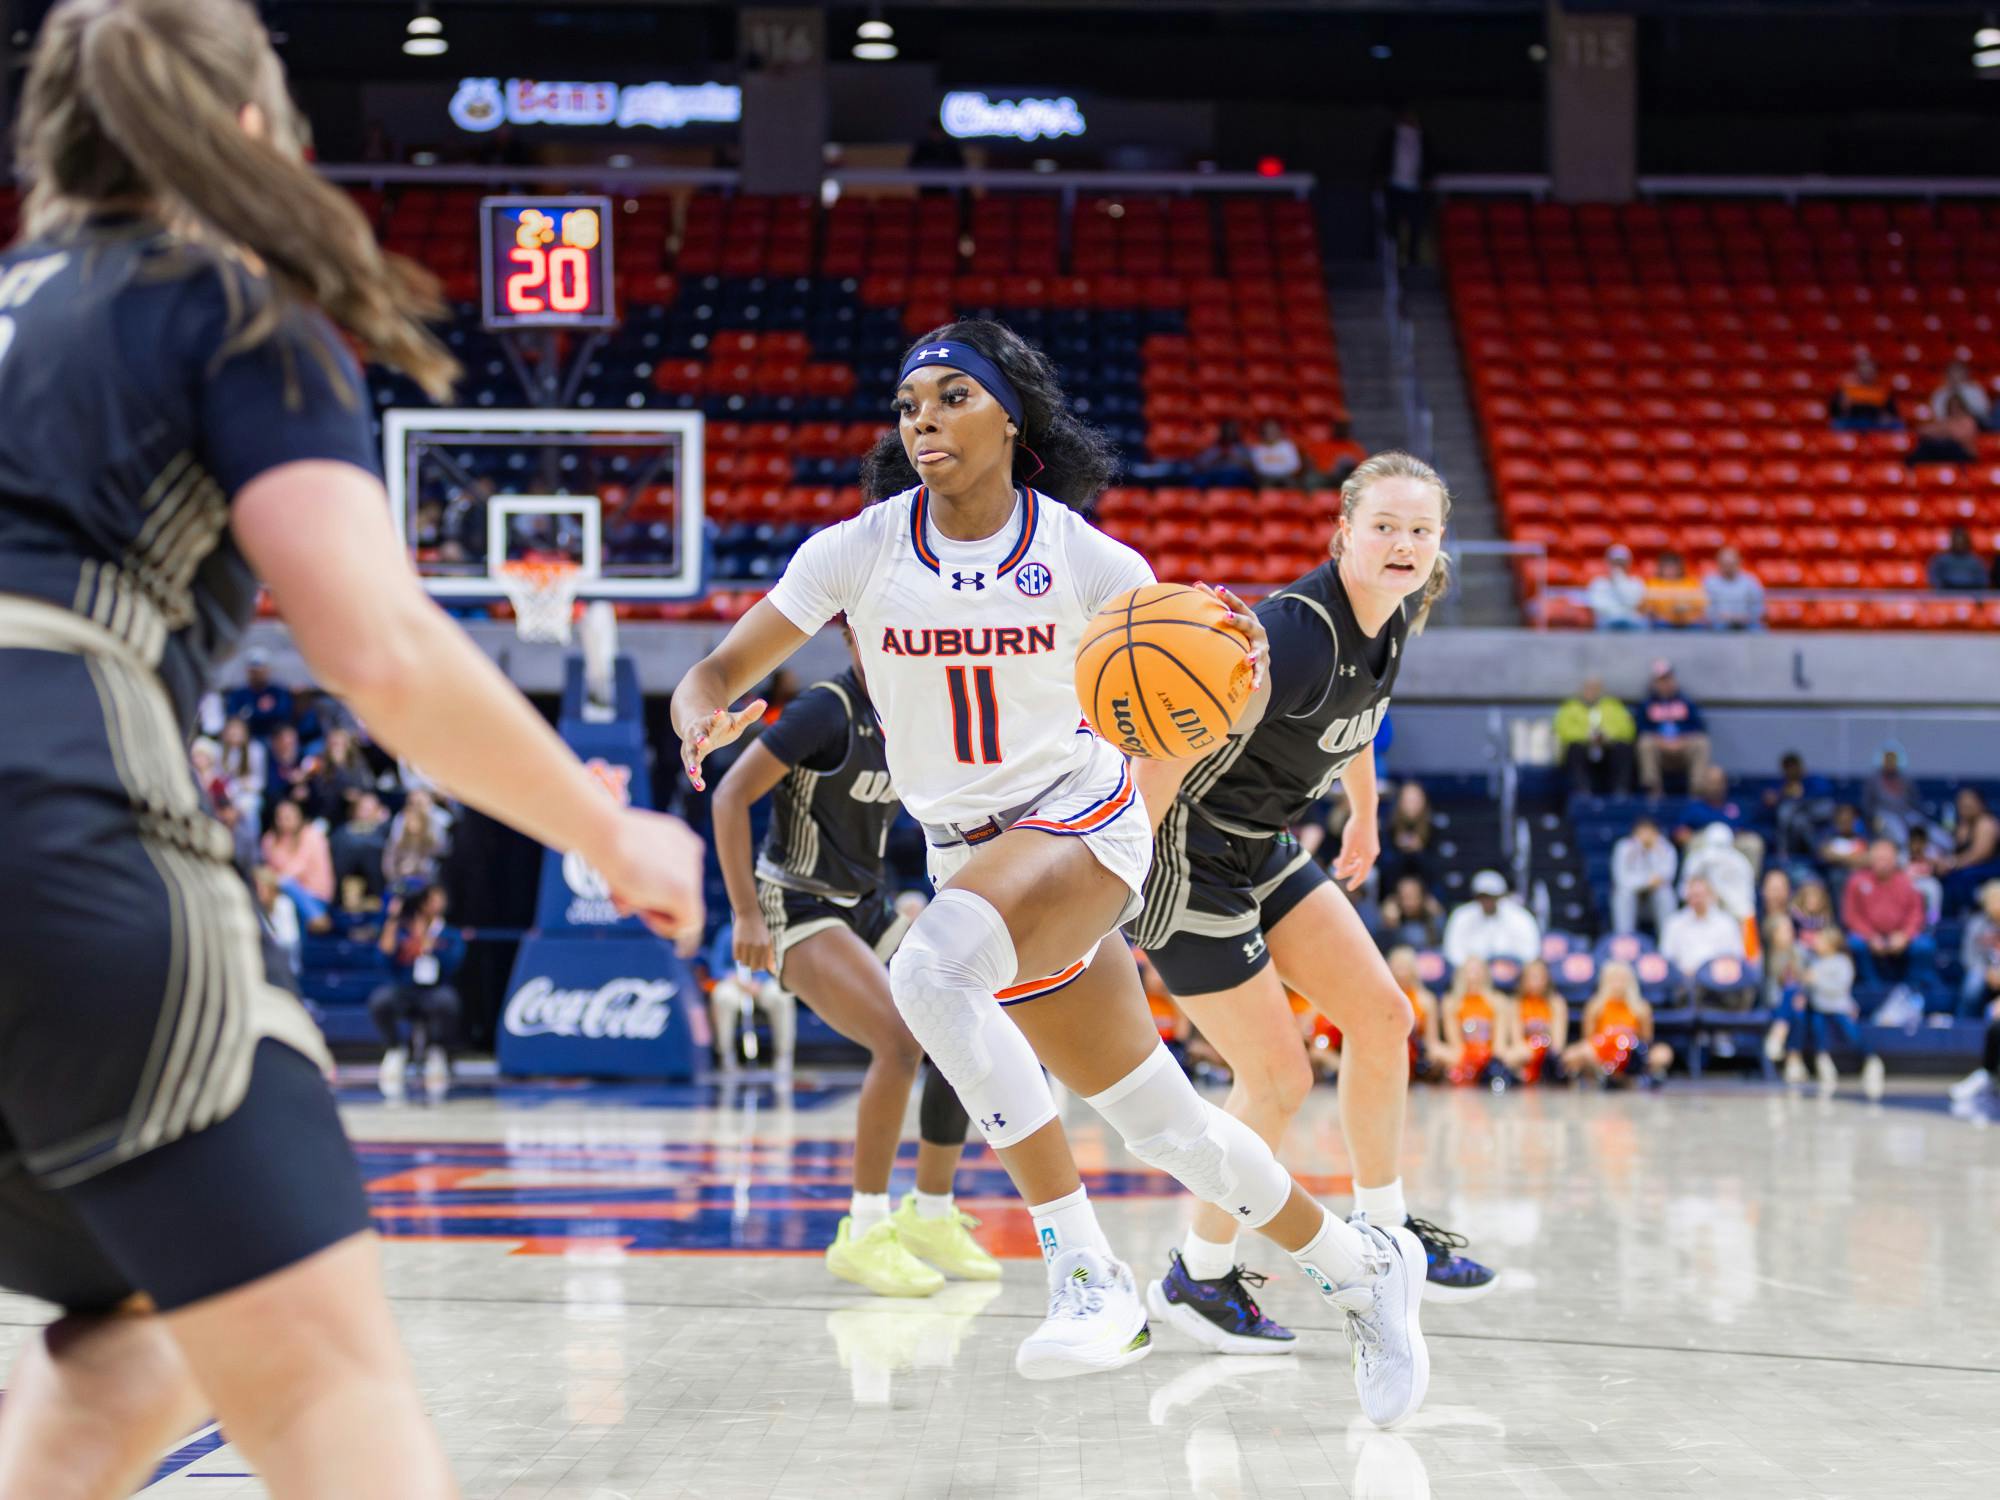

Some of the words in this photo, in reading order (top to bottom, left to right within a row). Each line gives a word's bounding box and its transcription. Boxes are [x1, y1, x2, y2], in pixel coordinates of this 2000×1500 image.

[507, 247, 590, 312] 20
[1017, 563, 1050, 595] SEC
[881, 623, 1056, 657] AUBURN
[945, 666, 1003, 765] 11
[1169, 707, 1215, 750] EVO
